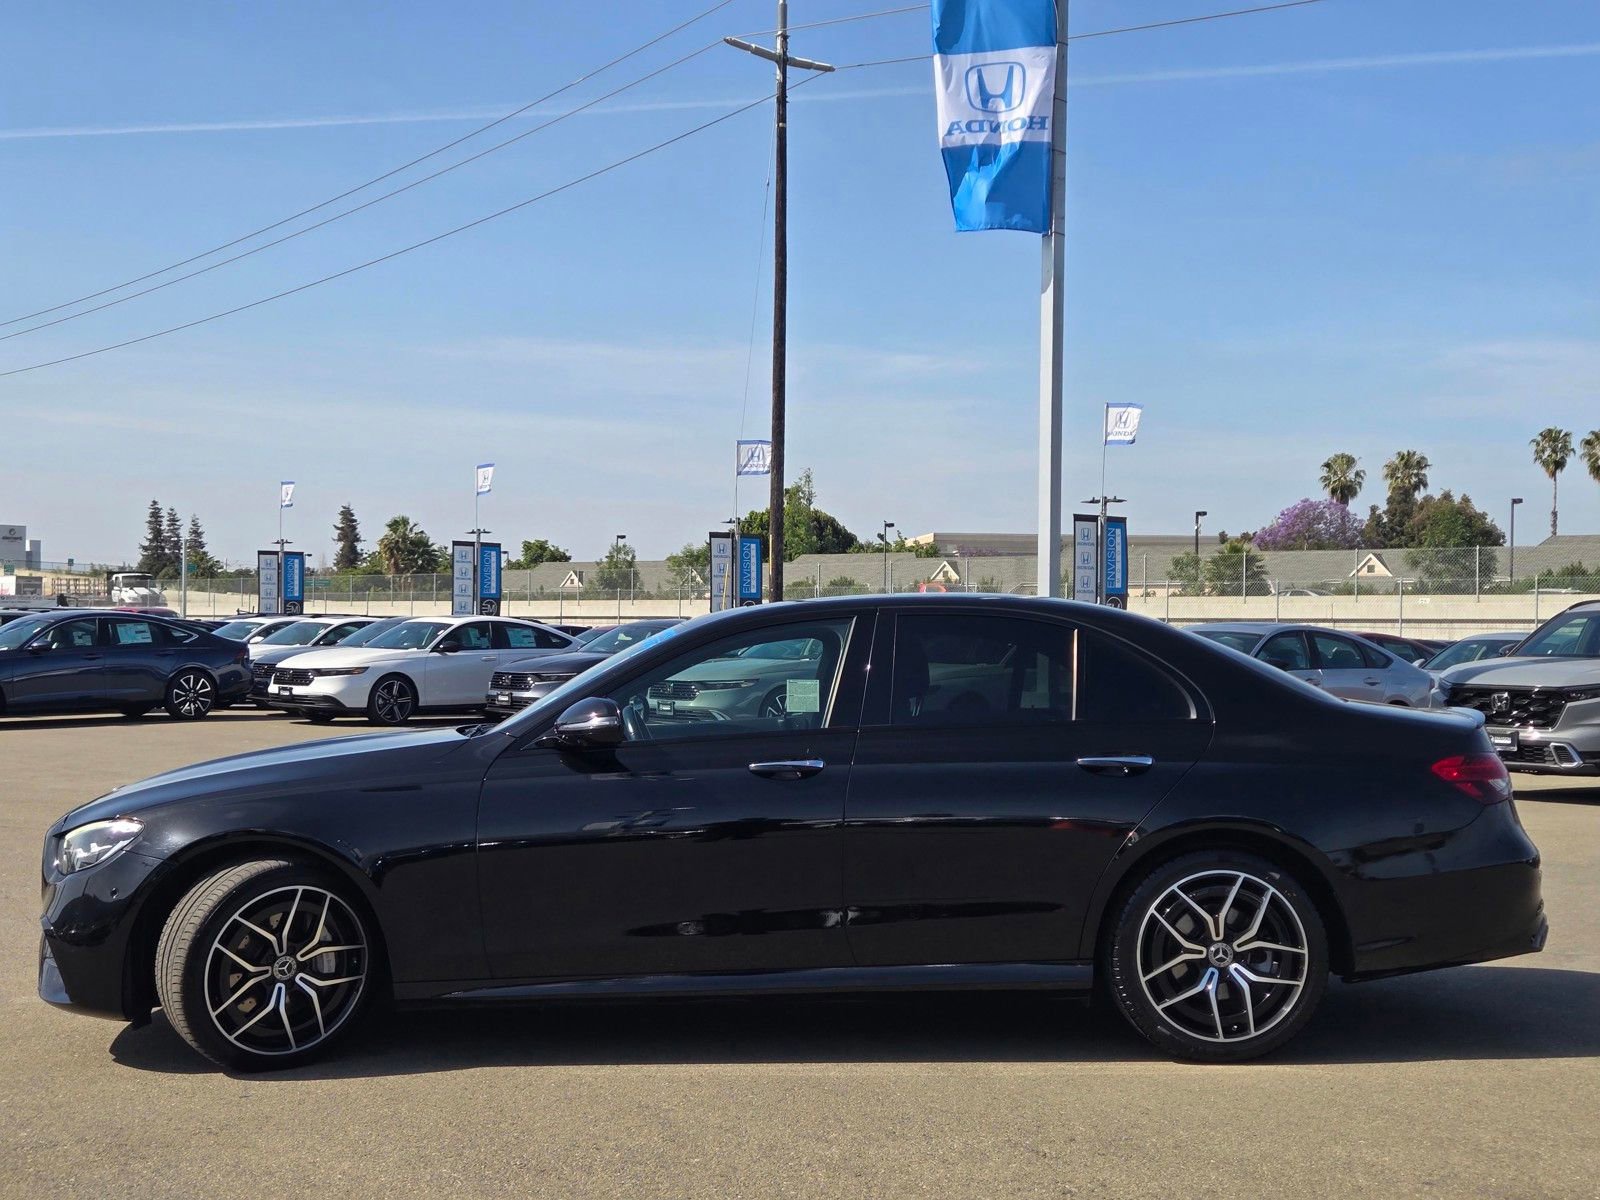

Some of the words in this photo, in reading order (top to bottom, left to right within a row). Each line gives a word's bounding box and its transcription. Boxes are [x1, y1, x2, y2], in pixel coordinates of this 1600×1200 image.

[287, 558, 295, 597] ENVISION
[483, 550, 491, 593] ENVISION
[742, 543, 751, 593] ENVISION
[1107, 527, 1115, 588] ENVISION
